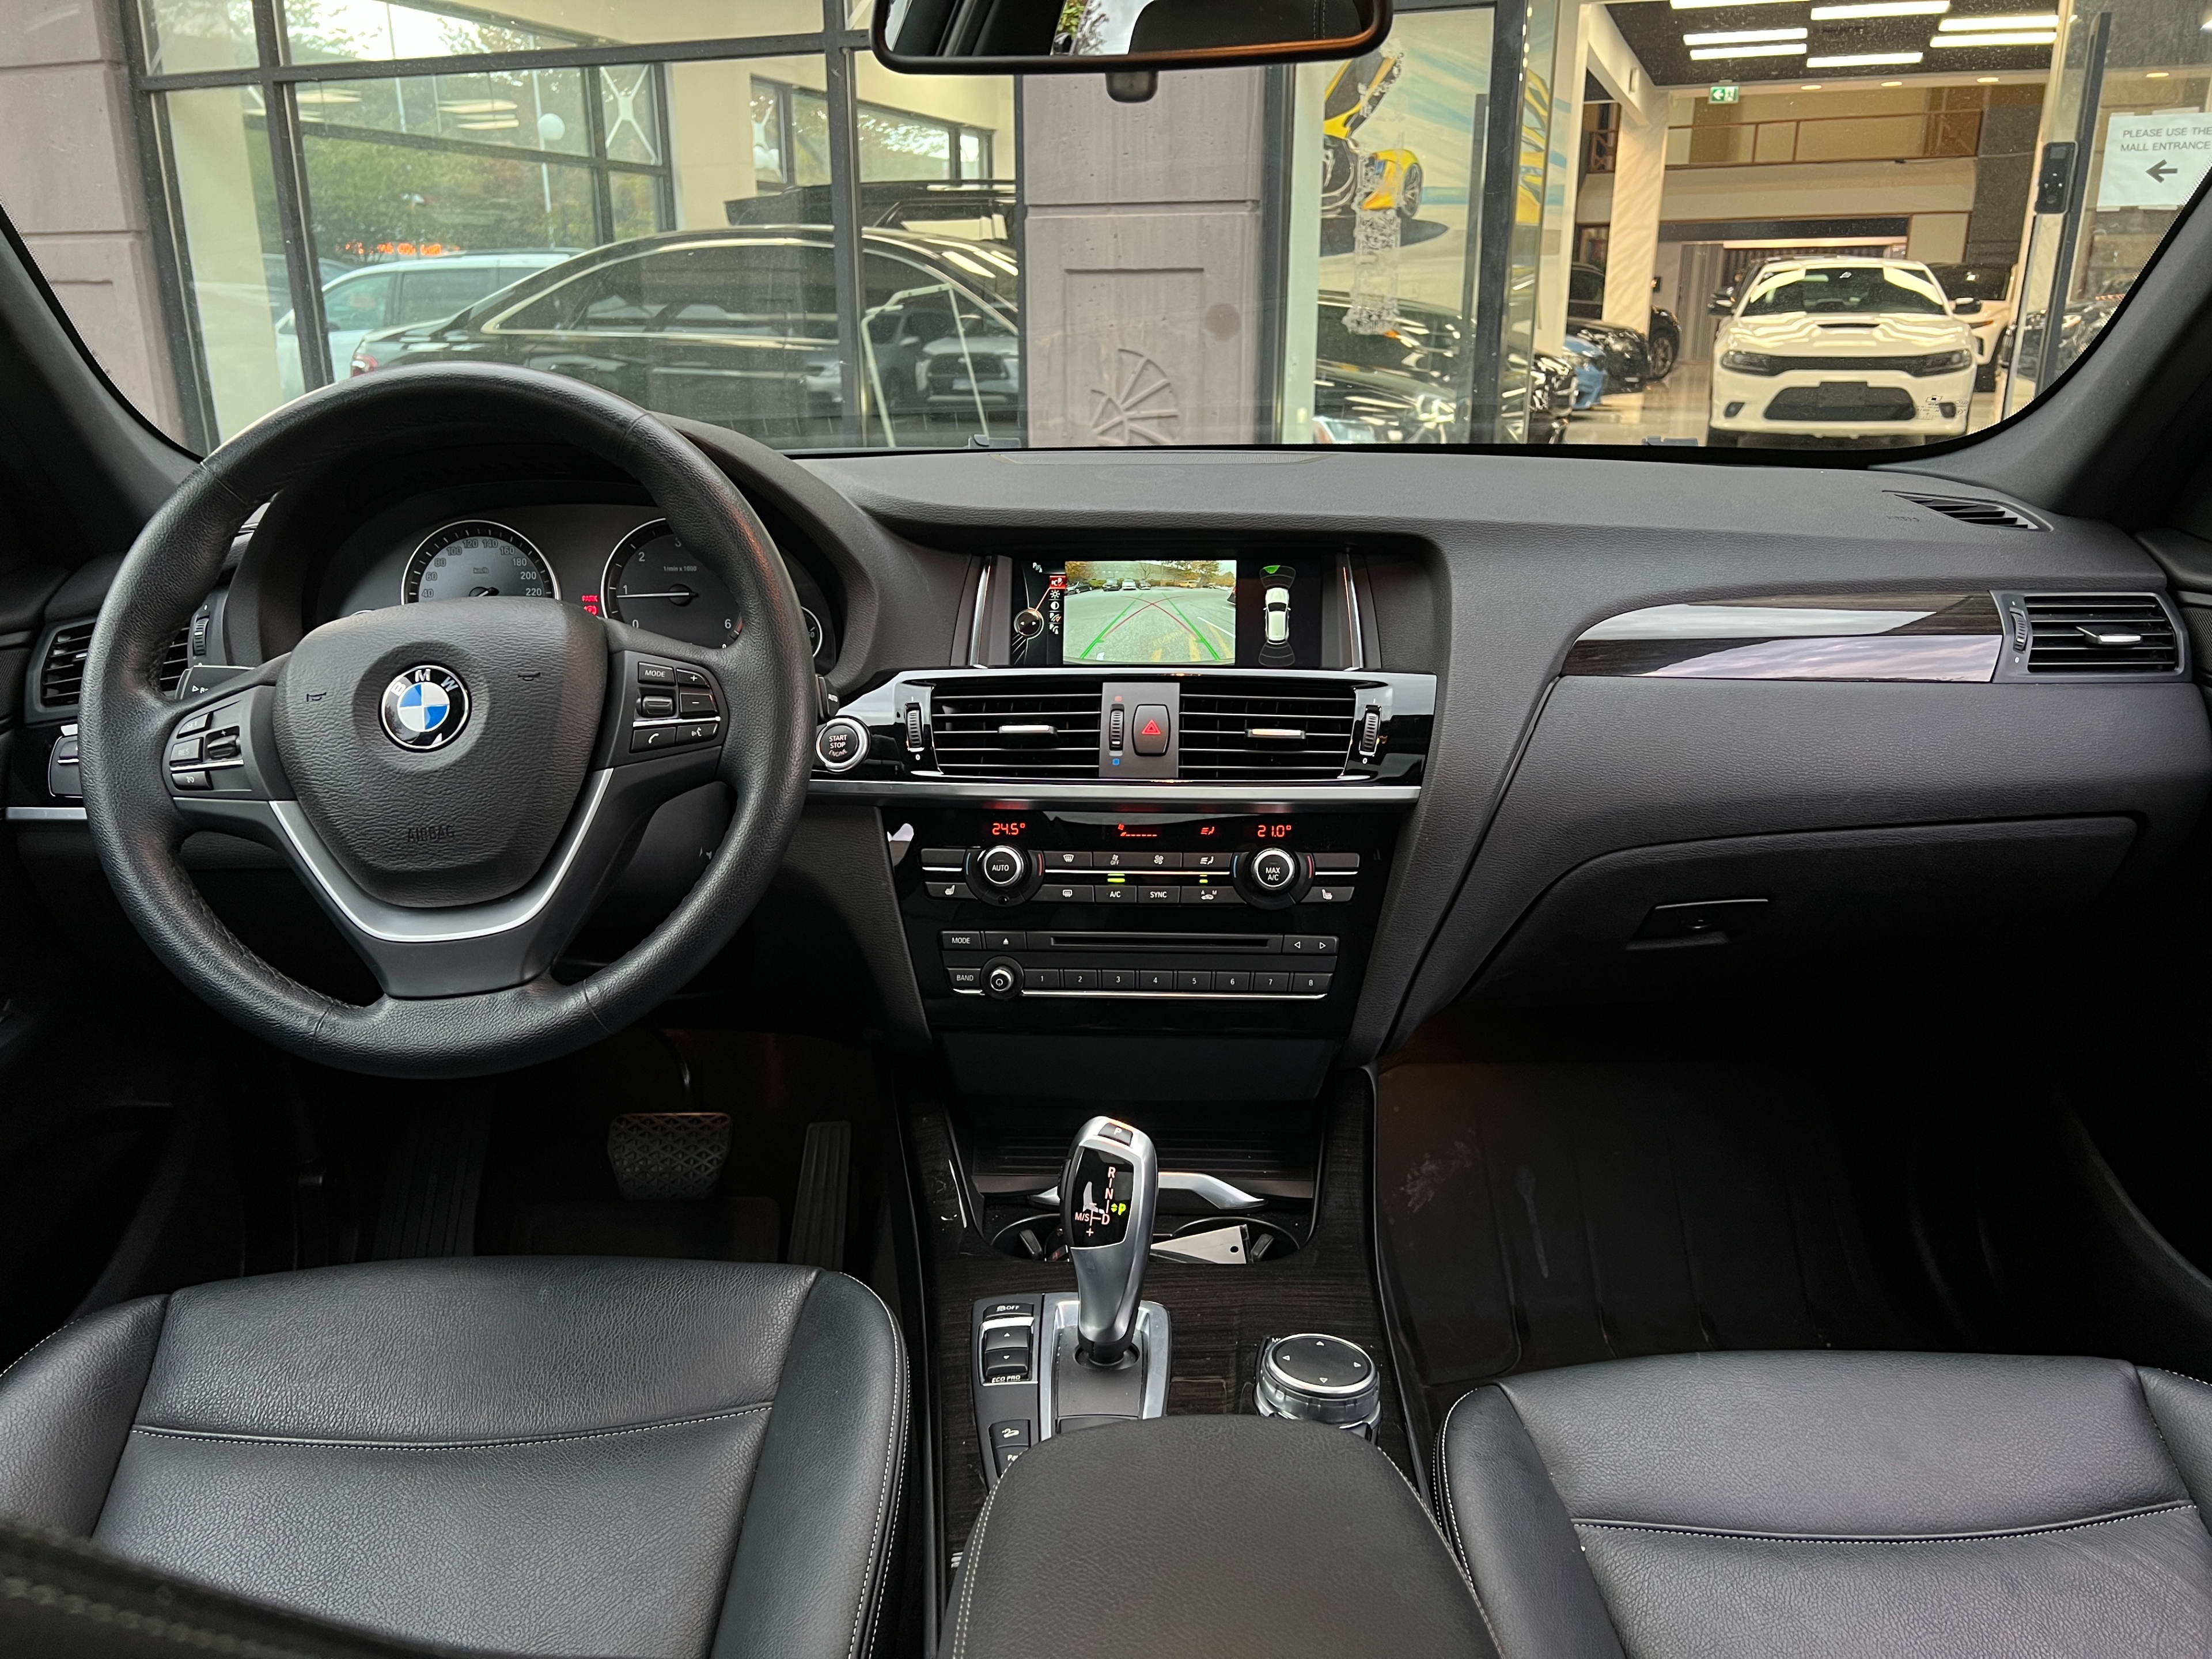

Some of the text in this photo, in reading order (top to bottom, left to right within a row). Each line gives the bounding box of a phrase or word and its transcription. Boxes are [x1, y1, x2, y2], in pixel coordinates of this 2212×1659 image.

[2123, 126, 2212, 138] PLEASE USE THE
[2120, 141, 2211, 151] MALL ENTRANCE
[463, 539, 478, 548] 120
[482, 539, 498, 548] 140
[446, 547, 462, 555] 100
[499, 547, 515, 555] 160
[638, 552, 645, 562] 2
[434, 558, 446, 567] 80
[513, 558, 527, 566] 180
[426, 572, 437, 581] 60
[520, 571, 536, 579] 200
[422, 589, 434, 597] 40
[526, 588, 541, 596] 220
[623, 585, 628, 594] 1
[725, 619, 731, 628] 6
[645, 669, 666, 677] MODE
[391, 668, 459, 696] BMW
[178, 748, 190, 756] RES
[828, 749, 848, 757] ENGINE
[1113, 1127, 1122, 1135] P
[1108, 1166, 1116, 1178] R
[1105, 1188, 1113, 1200] N
[1118, 1203, 1126, 1215] P
[1075, 1212, 1090, 1222] M/S
[1101, 1214, 1110, 1225] D
